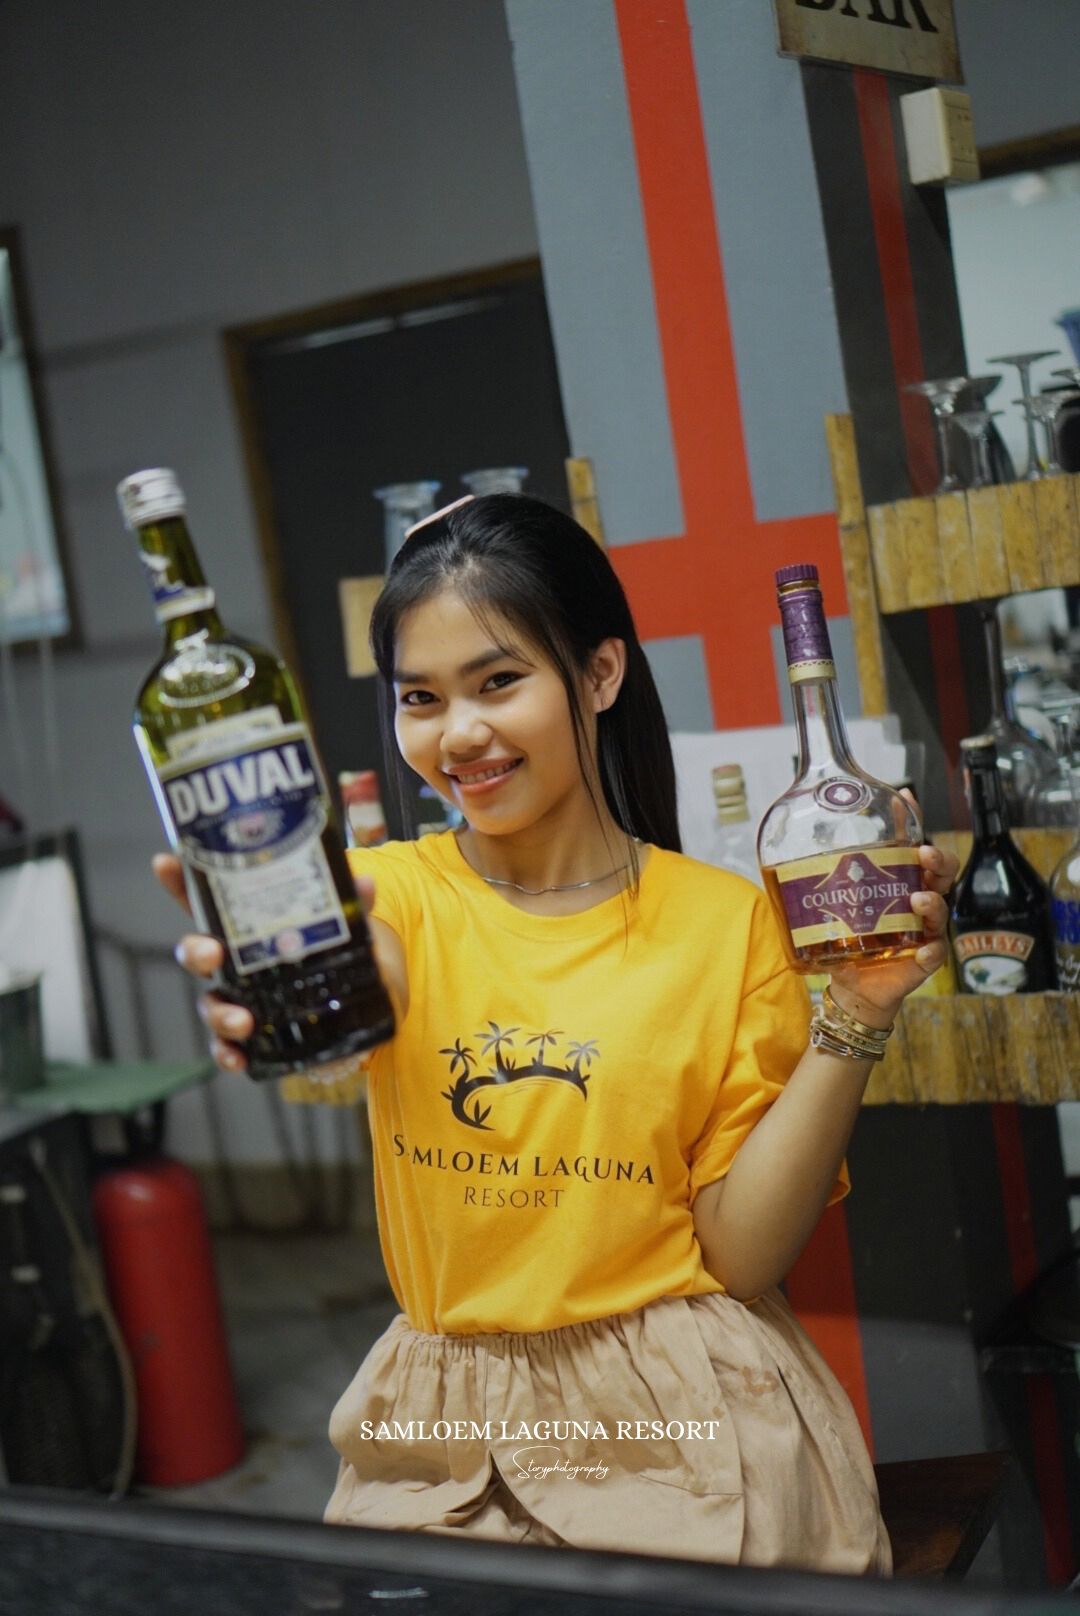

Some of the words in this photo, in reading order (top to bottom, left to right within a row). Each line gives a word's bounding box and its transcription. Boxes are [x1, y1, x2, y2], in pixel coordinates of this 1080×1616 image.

[167, 744, 315, 826] DUVAL
[802, 882, 911, 909] COURVOISIER
[393, 1134, 519, 1176] SMLOEM
[534, 1155, 655, 1185] LAGUNA
[463, 1186, 564, 1209] RESORT
